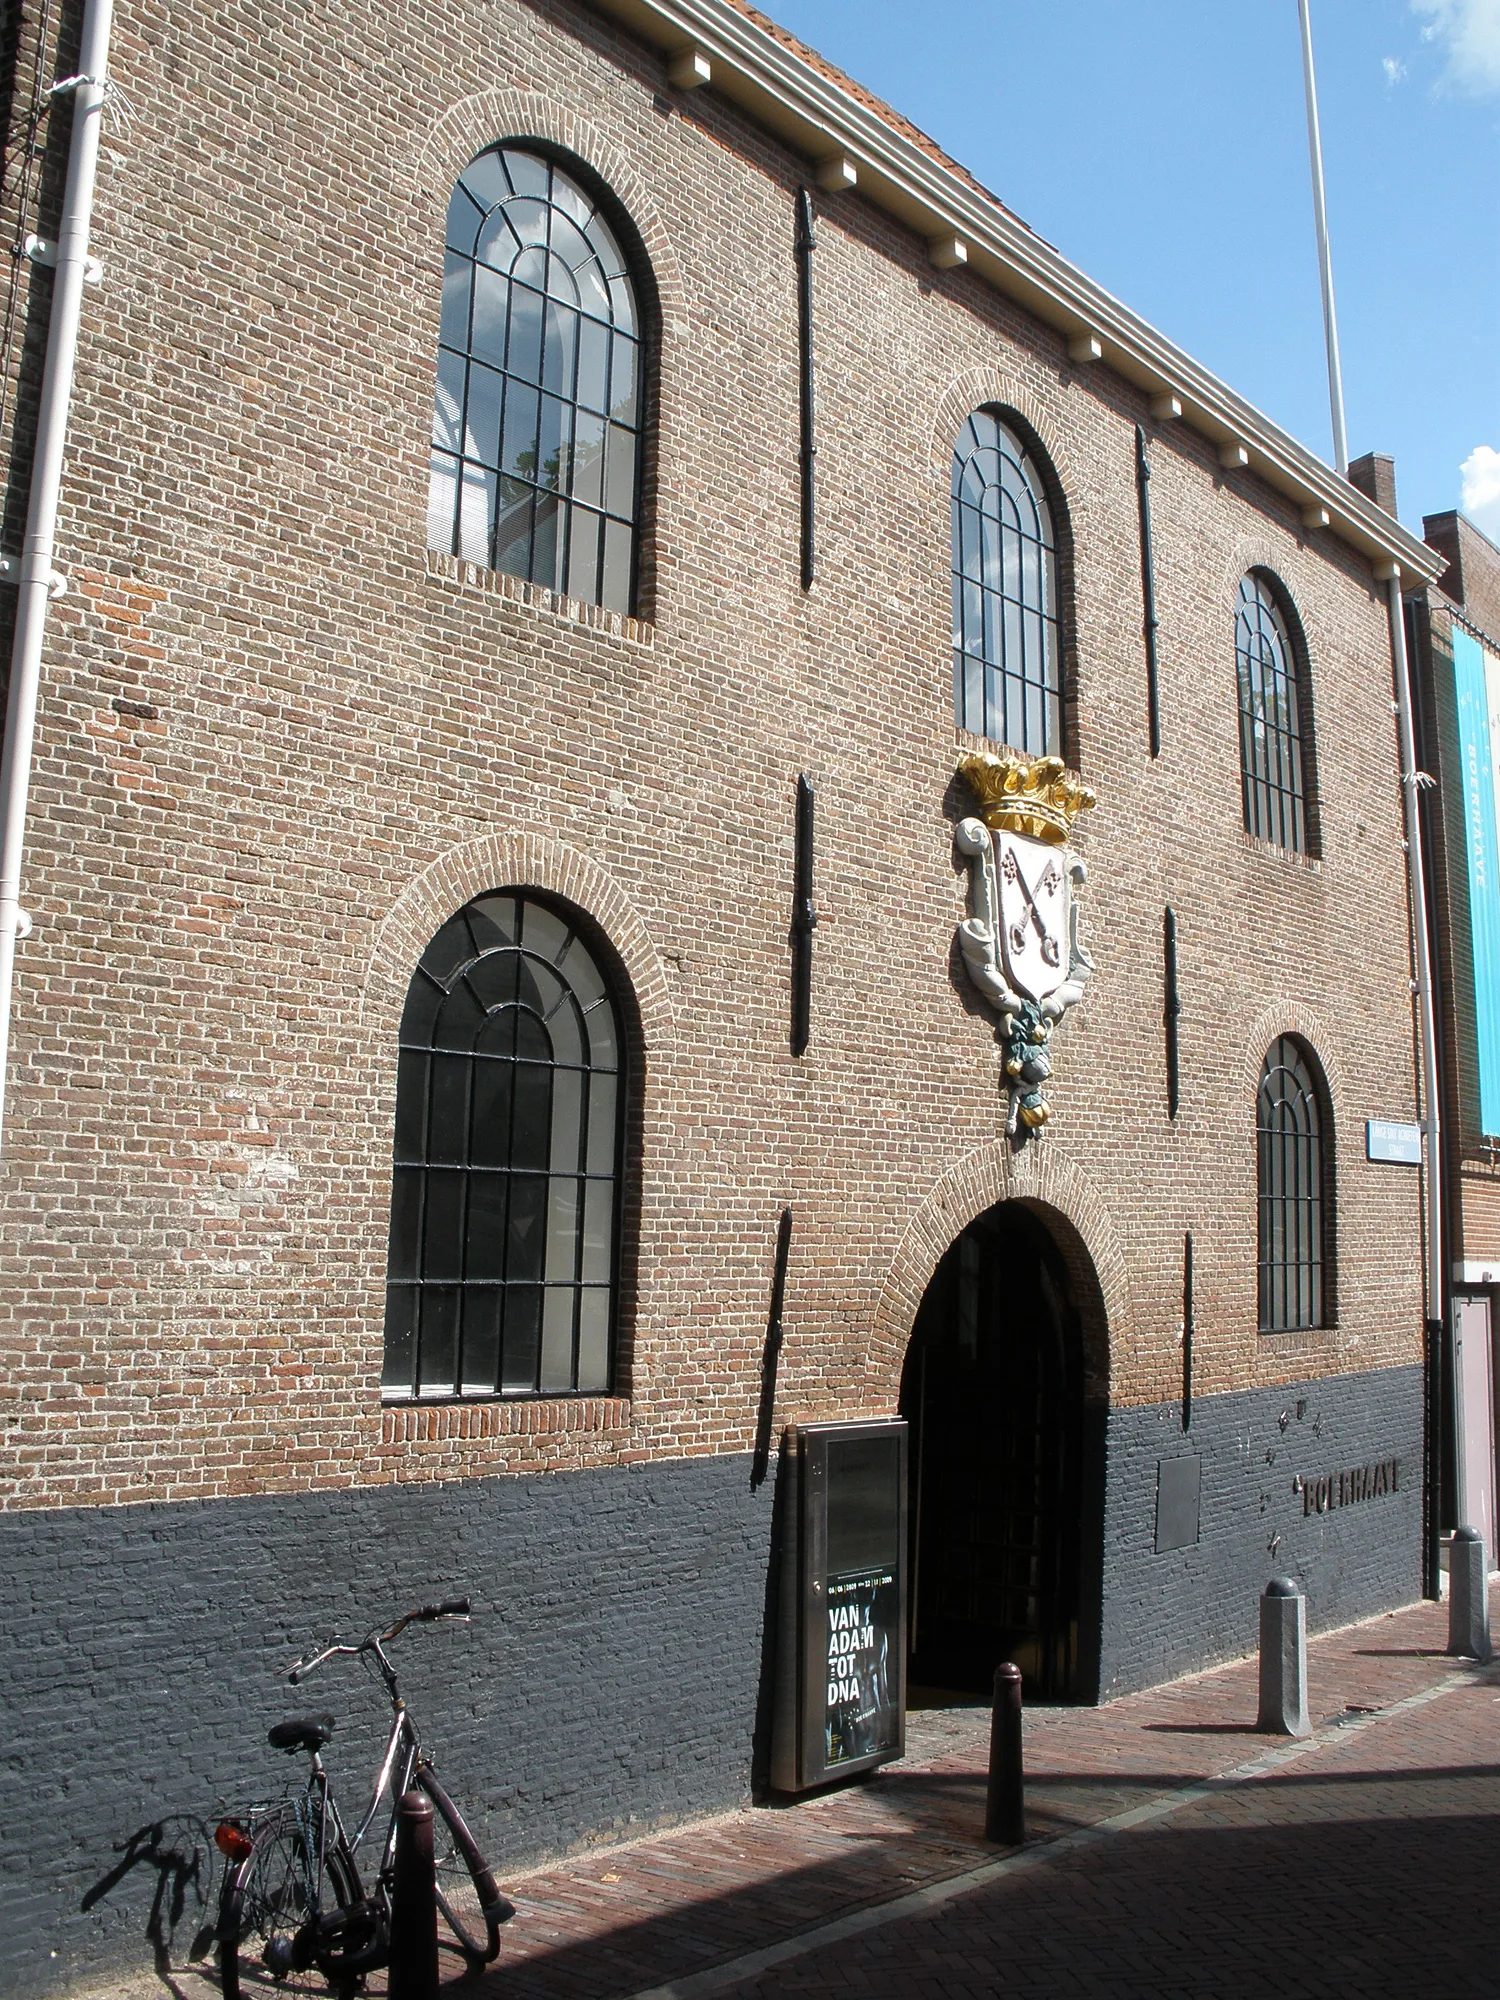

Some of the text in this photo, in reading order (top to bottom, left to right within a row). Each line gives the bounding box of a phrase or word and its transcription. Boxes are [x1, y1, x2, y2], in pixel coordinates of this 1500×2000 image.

[1467, 743, 1487, 888] BOERHAAVE
[1302, 1458, 1400, 1517] BOERHAAVE
[828, 1604, 859, 1631] VAN
[828, 1625, 874, 1656] ADAM
[828, 1654, 856, 1680] TOT
[828, 1677, 860, 1706] DNA
